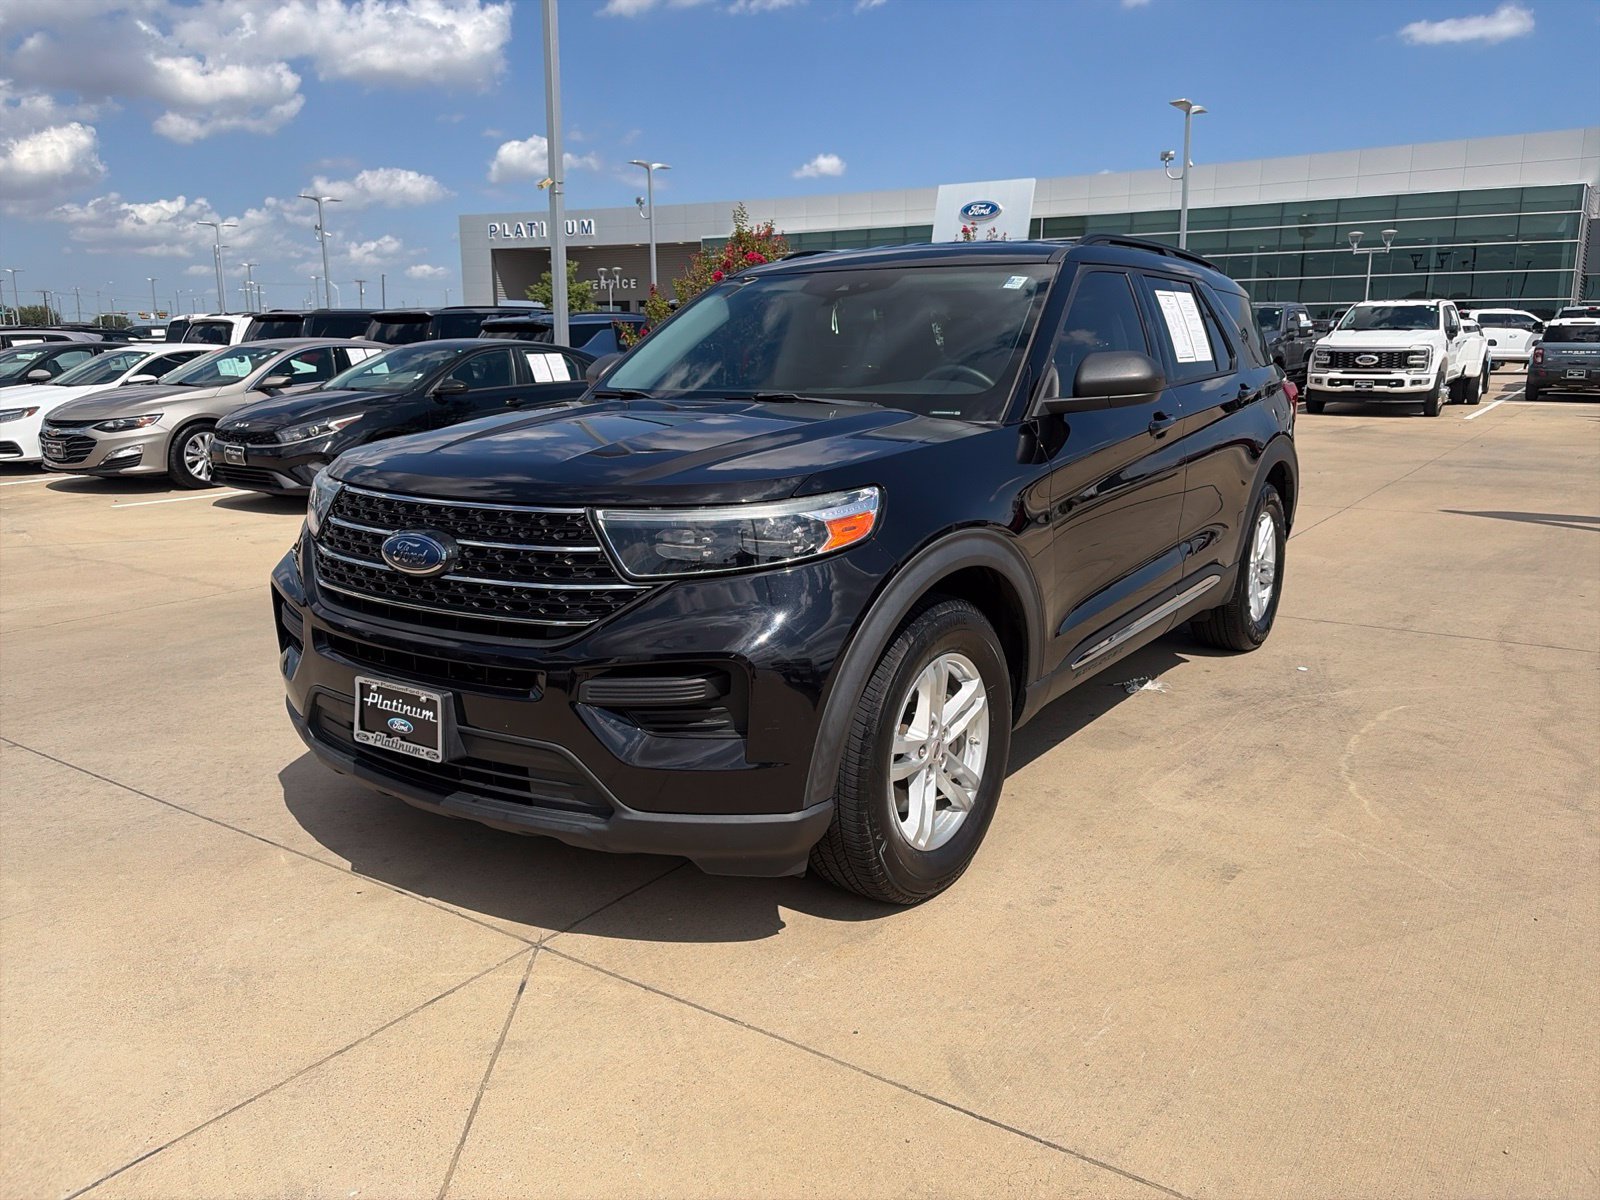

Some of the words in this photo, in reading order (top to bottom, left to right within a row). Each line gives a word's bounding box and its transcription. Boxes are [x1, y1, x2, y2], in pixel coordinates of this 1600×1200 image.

[968, 204, 992, 216] Ford
[488, 218, 595, 239] PLATIUM
[589, 278, 637, 290] ERVICE
[392, 540, 430, 565] Ford
[363, 692, 438, 723] Platinum
[392, 719, 409, 732] Ford
[373, 733, 425, 756] Platinum
